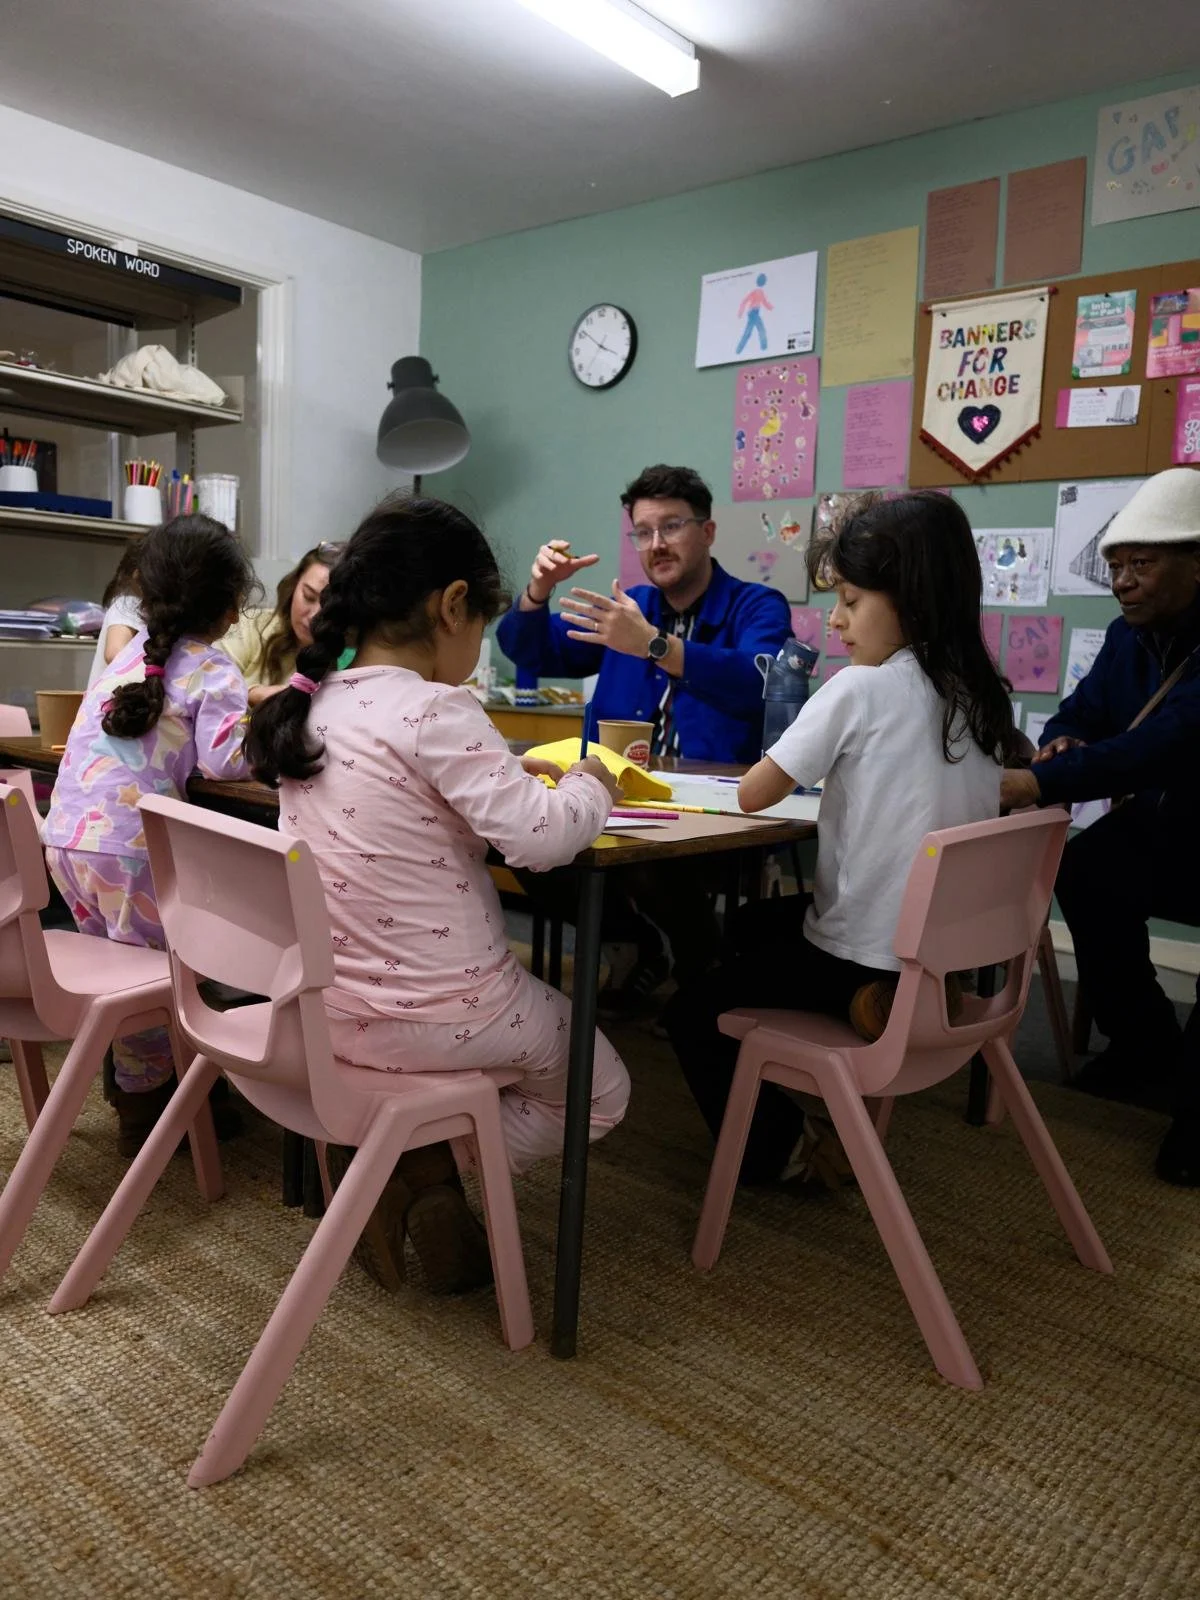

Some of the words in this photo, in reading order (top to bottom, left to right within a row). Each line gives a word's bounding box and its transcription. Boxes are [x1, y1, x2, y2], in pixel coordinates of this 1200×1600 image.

[66, 238, 117, 266] SPOKEN
[124, 255, 160, 278] WORD
[1091, 301, 1111, 310] Into
[1100, 306, 1122, 317] Park
[938, 318, 1037, 349] BANNERS
[957, 346, 1008, 377] FOR
[936, 373, 1020, 402] CHANGE
[1009, 616, 1049, 650] GAP
